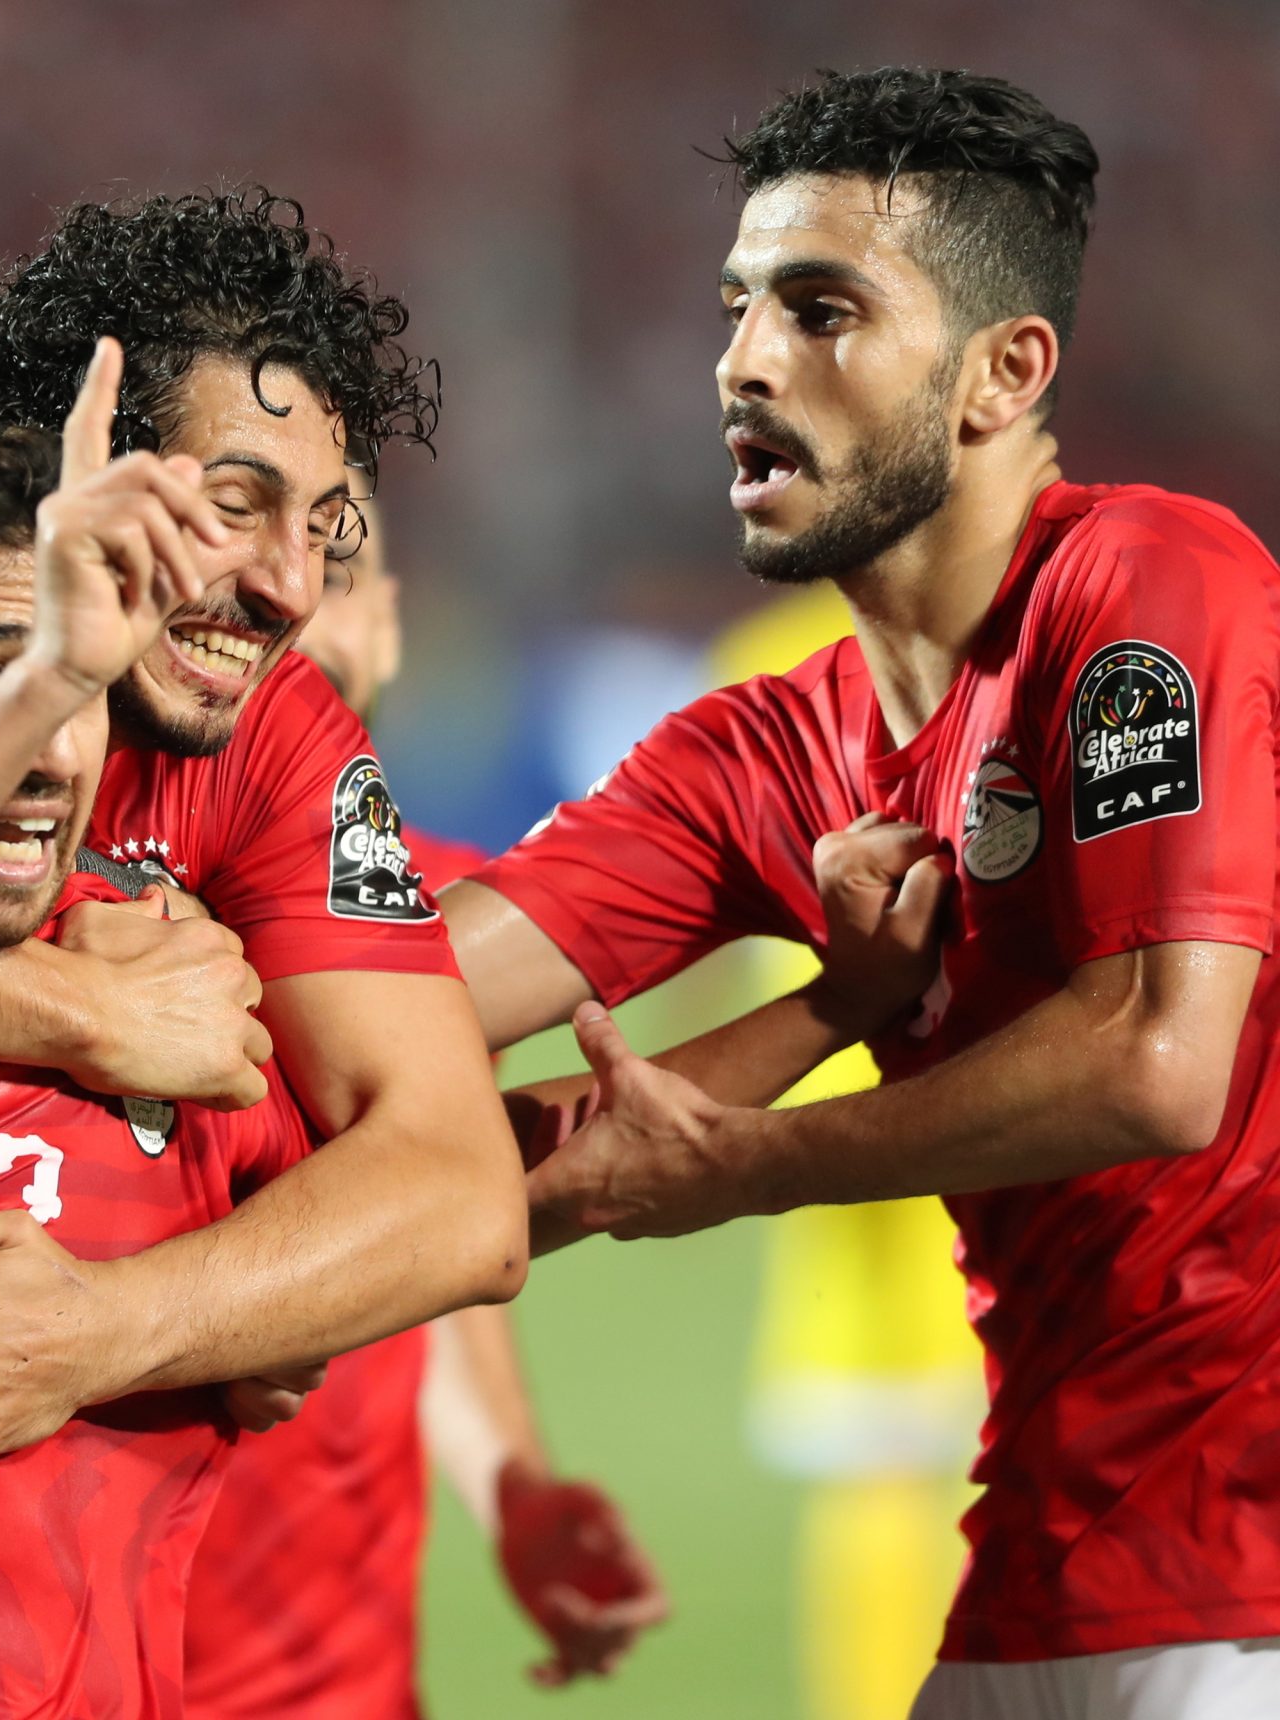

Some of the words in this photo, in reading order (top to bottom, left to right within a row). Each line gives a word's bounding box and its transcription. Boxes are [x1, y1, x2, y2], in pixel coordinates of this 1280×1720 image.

[1078, 719, 1190, 768] Celebrate
[1093, 743, 1164, 779] Africa
[1097, 783, 1171, 819] CAF
